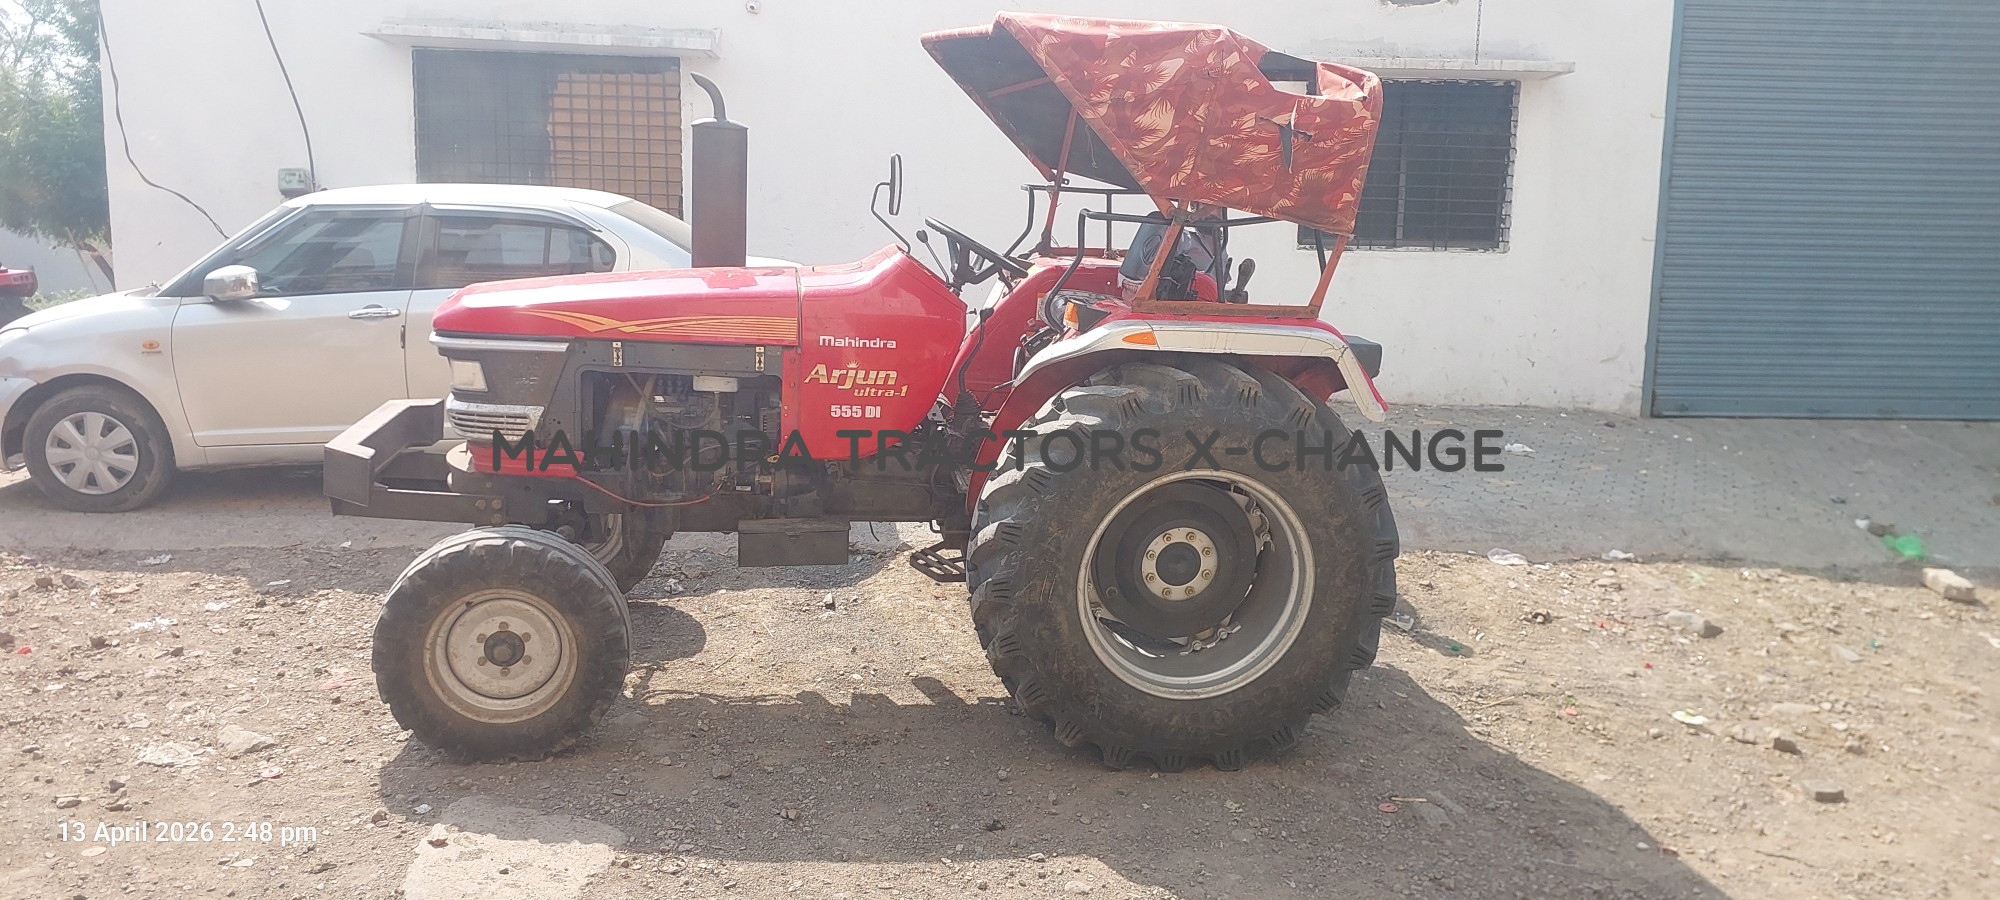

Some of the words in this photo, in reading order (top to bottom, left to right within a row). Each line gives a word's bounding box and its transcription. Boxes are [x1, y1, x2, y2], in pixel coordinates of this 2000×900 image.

[819, 335, 897, 349] Mahindra
[803, 361, 898, 390] Arjun
[853, 384, 909, 397] ultra-1
[830, 404, 862, 418] 555
[864, 405, 881, 418] DI
